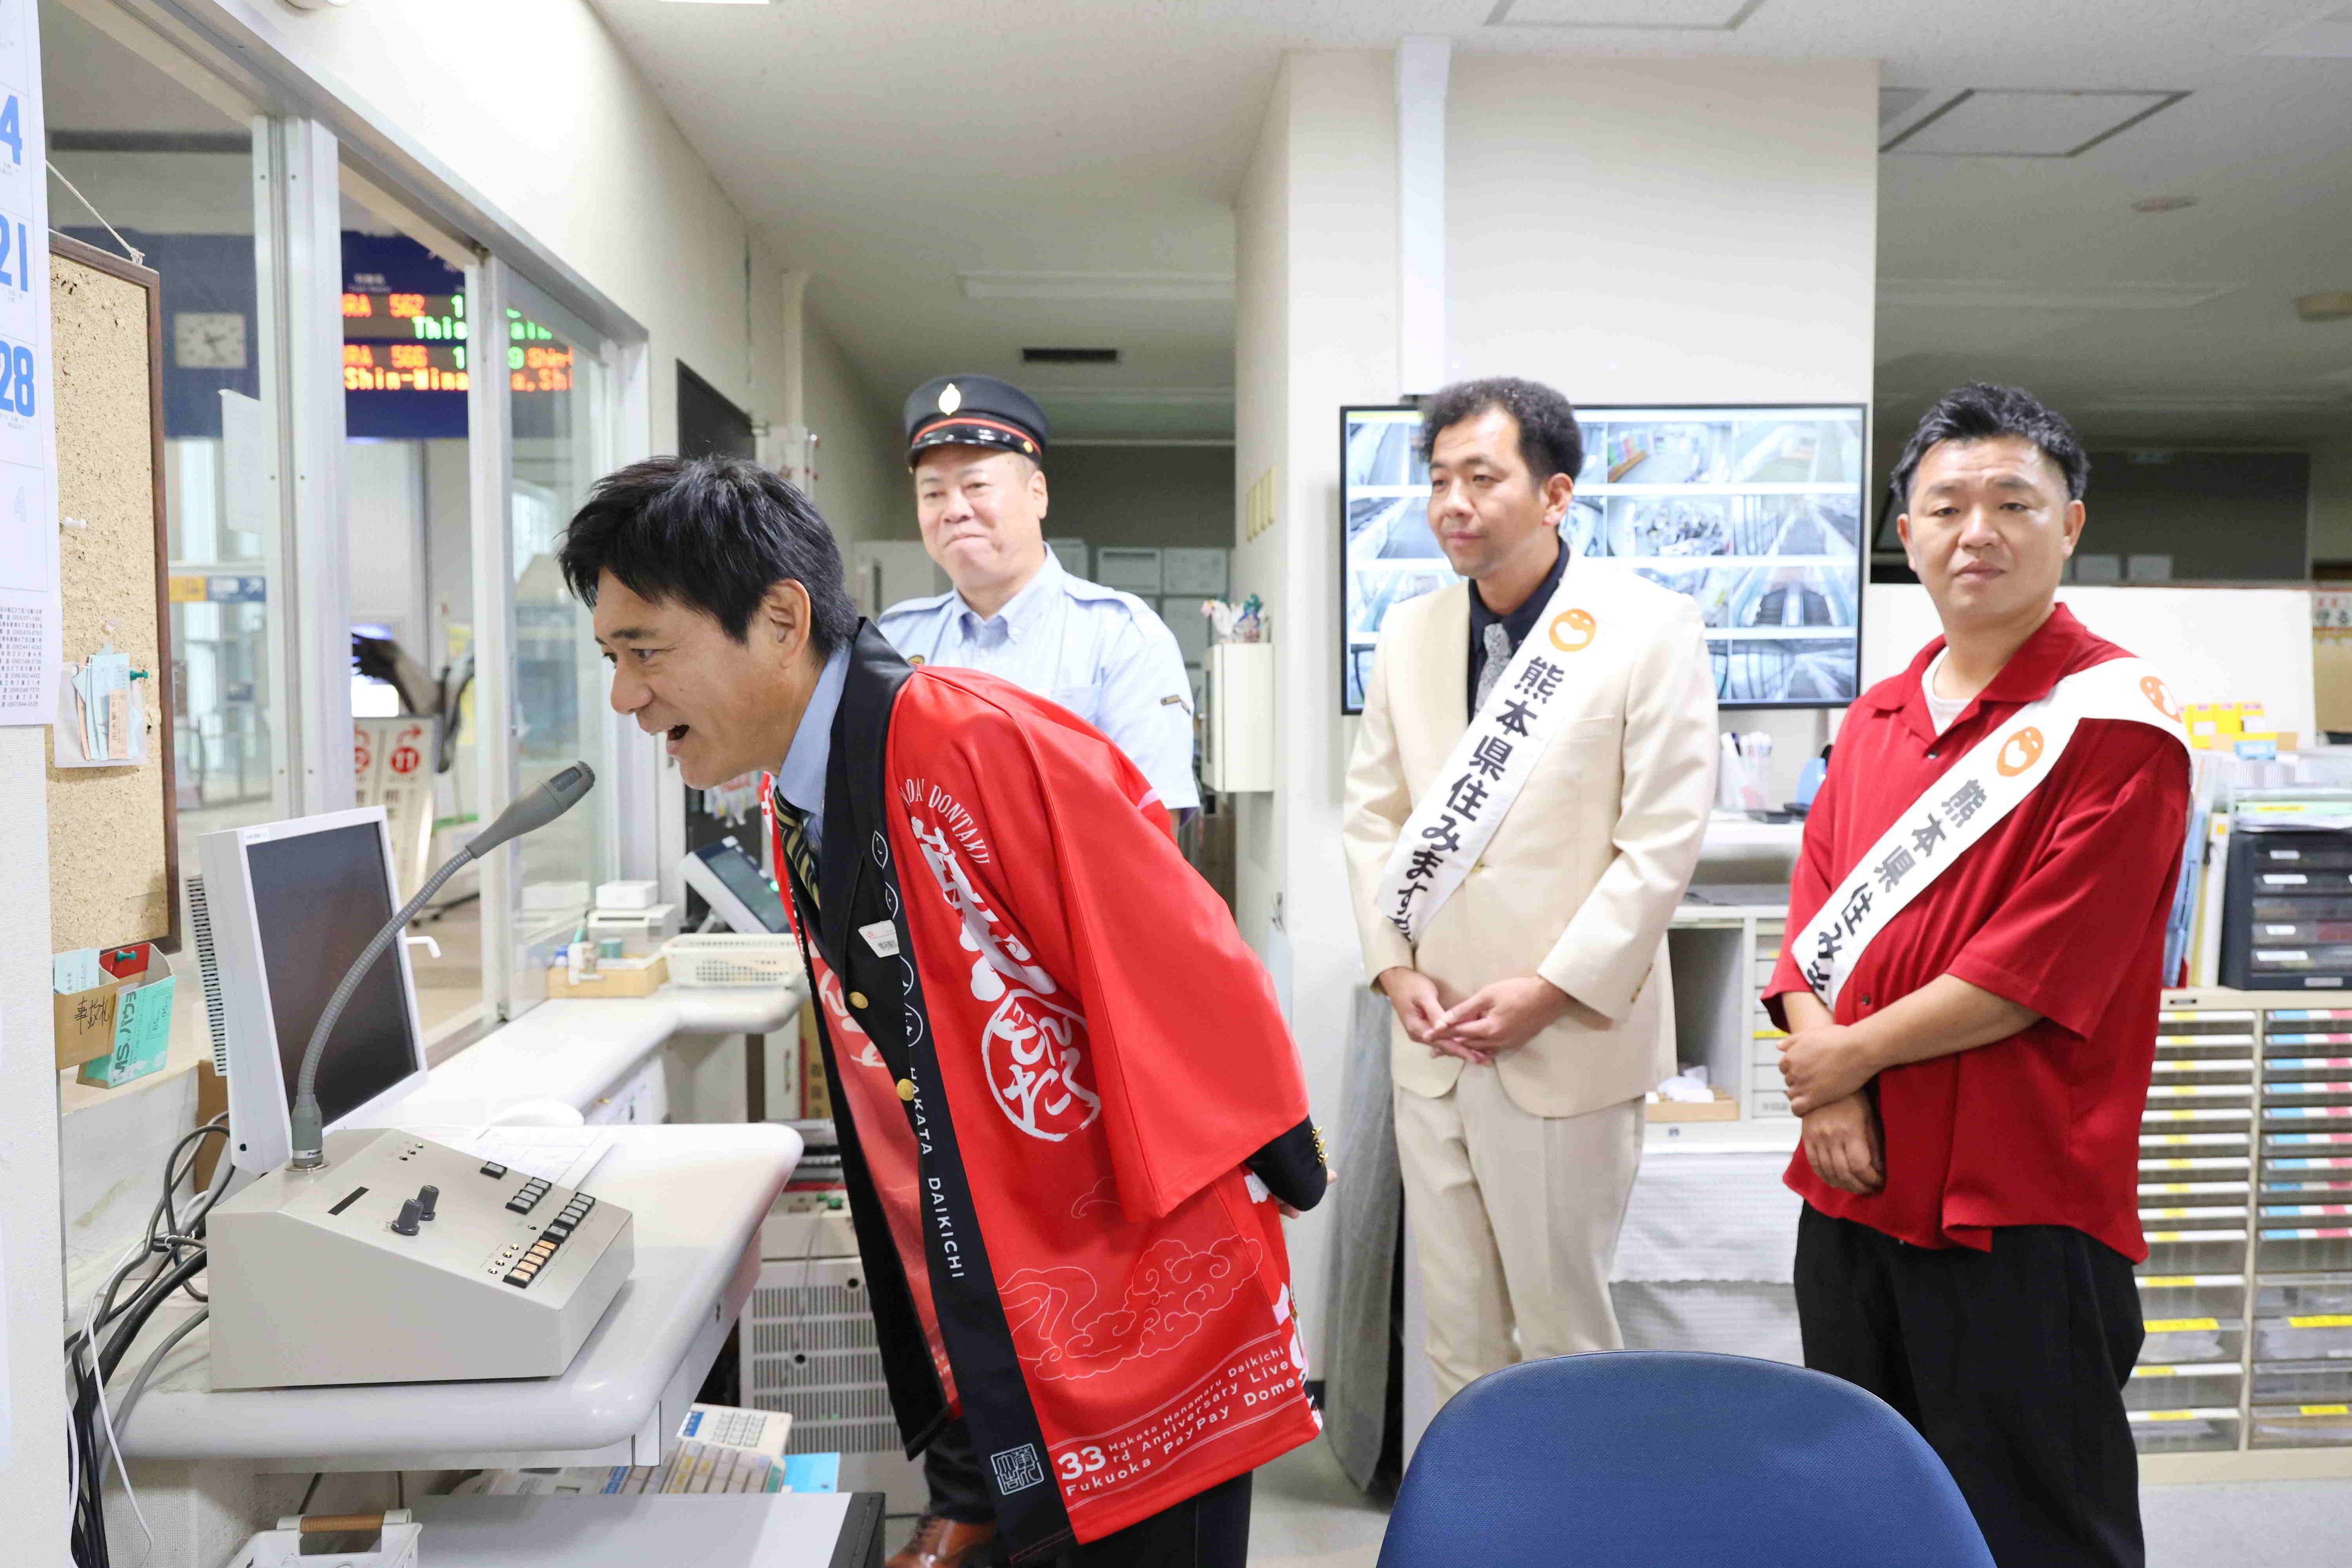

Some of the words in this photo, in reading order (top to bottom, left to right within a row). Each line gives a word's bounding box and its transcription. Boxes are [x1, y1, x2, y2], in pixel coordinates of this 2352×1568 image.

[928, 1177, 965, 1279] DAIKICHI
[1057, 1444, 1107, 1481] 33
[1112, 1447, 1131, 1463] rd
[1141, 1381, 1239, 1452] Anniversary
[1250, 1360, 1289, 1384] Live
[1066, 1456, 1152, 1497] Fukuoka
[1163, 1404, 1230, 1454] PayPay
[1244, 1377, 1296, 1408] Dome
[1109, 1426, 1158, 1452] Hakata
[1164, 1379, 1222, 1423] Hanamaru
[1228, 1346, 1285, 1378] Daikichi
